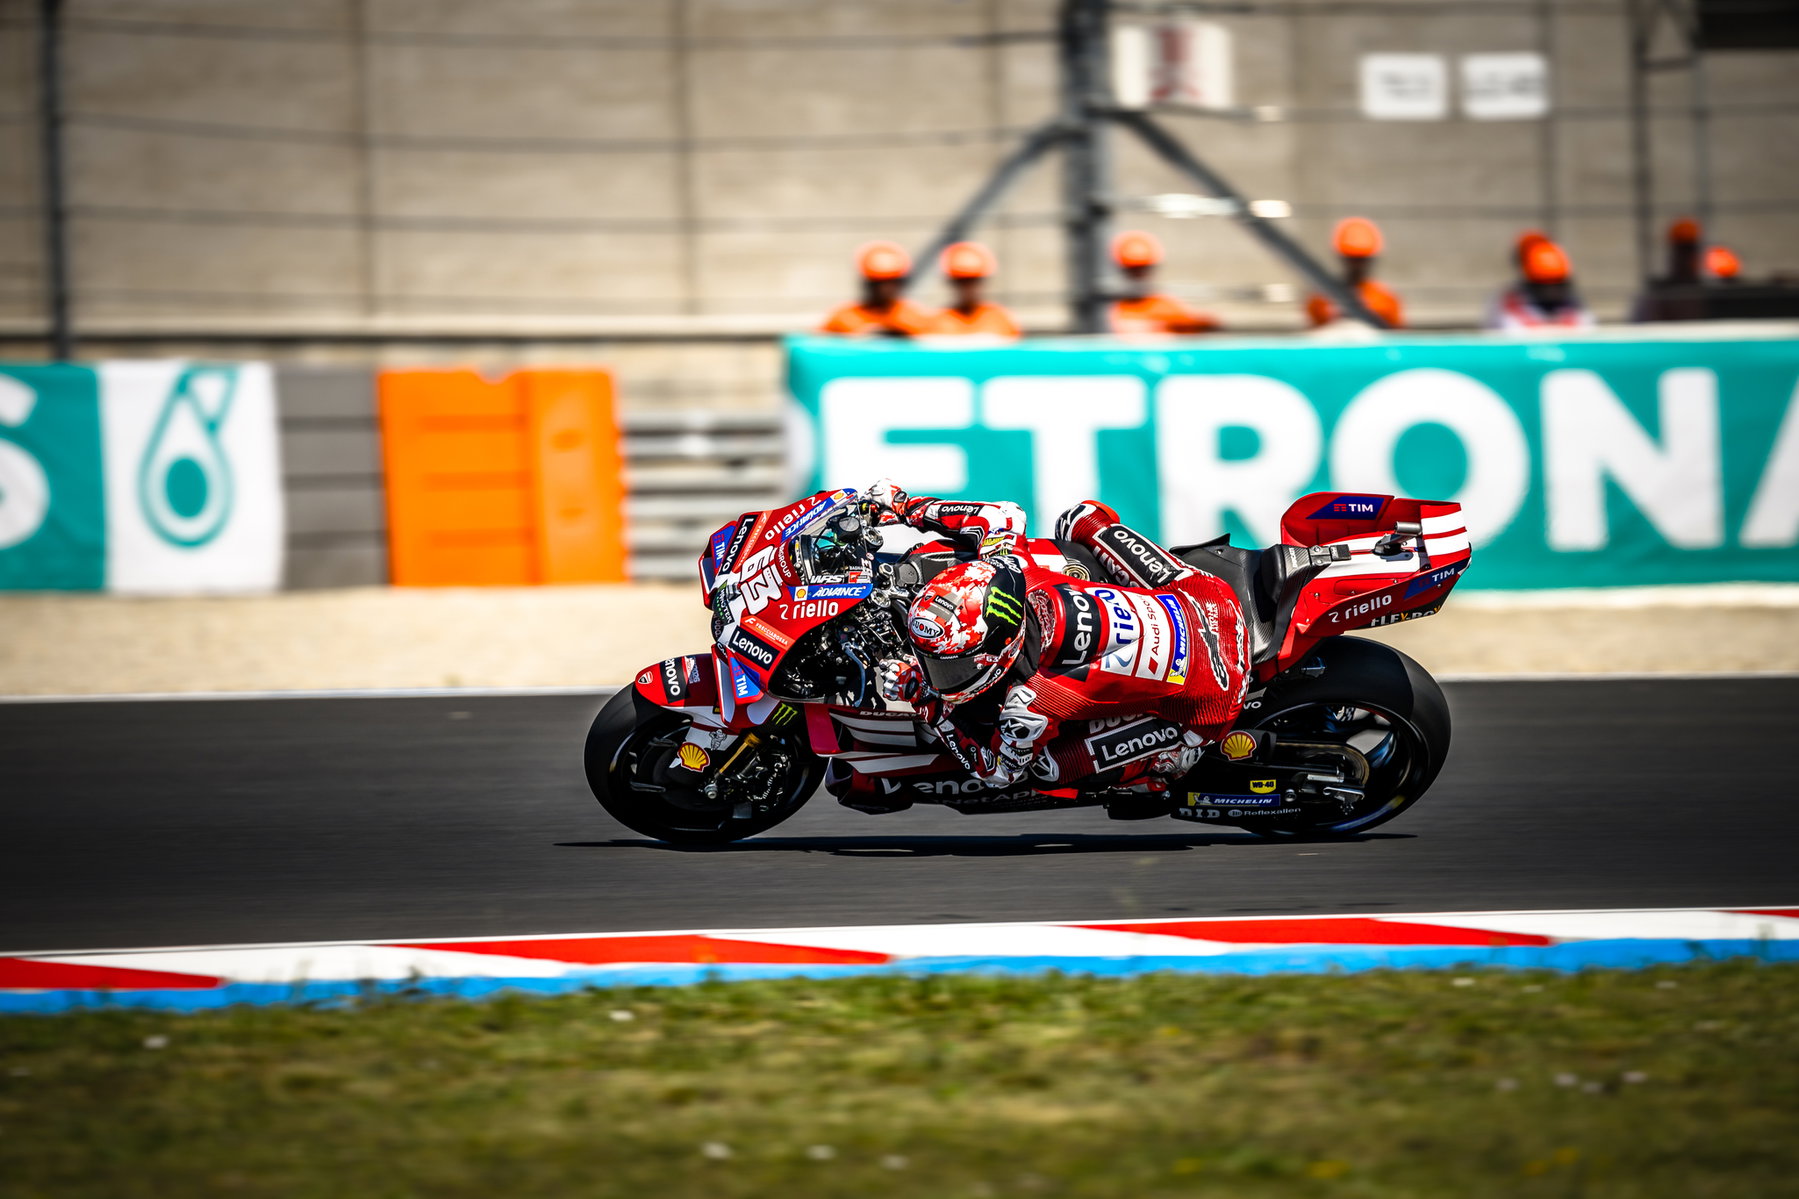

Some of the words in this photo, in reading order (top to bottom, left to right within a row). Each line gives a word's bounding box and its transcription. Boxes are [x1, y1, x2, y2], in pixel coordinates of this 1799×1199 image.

[941, 505, 980, 514] Lenovo
[1349, 503, 1374, 513] TIM
[765, 503, 806, 541] riello
[715, 541, 727, 561] TIM
[722, 518, 754, 572] Lenovo
[1113, 530, 1173, 584] Lenovo
[810, 574, 845, 584] WRS
[1432, 567, 1455, 582] TIM
[812, 586, 862, 598] ADVANCE
[935, 595, 954, 610] Lenovo
[792, 600, 839, 620] riello
[1139, 595, 1157, 621] Spo
[1345, 594, 1393, 620] riello
[1151, 624, 1160, 656] Audi
[1165, 598, 1188, 656] MICHELIN
[732, 631, 773, 665] Lenovo
[736, 675, 749, 696] TIM
[946, 734, 971, 770] Lenovo
[1101, 726, 1178, 762] Lenovo
